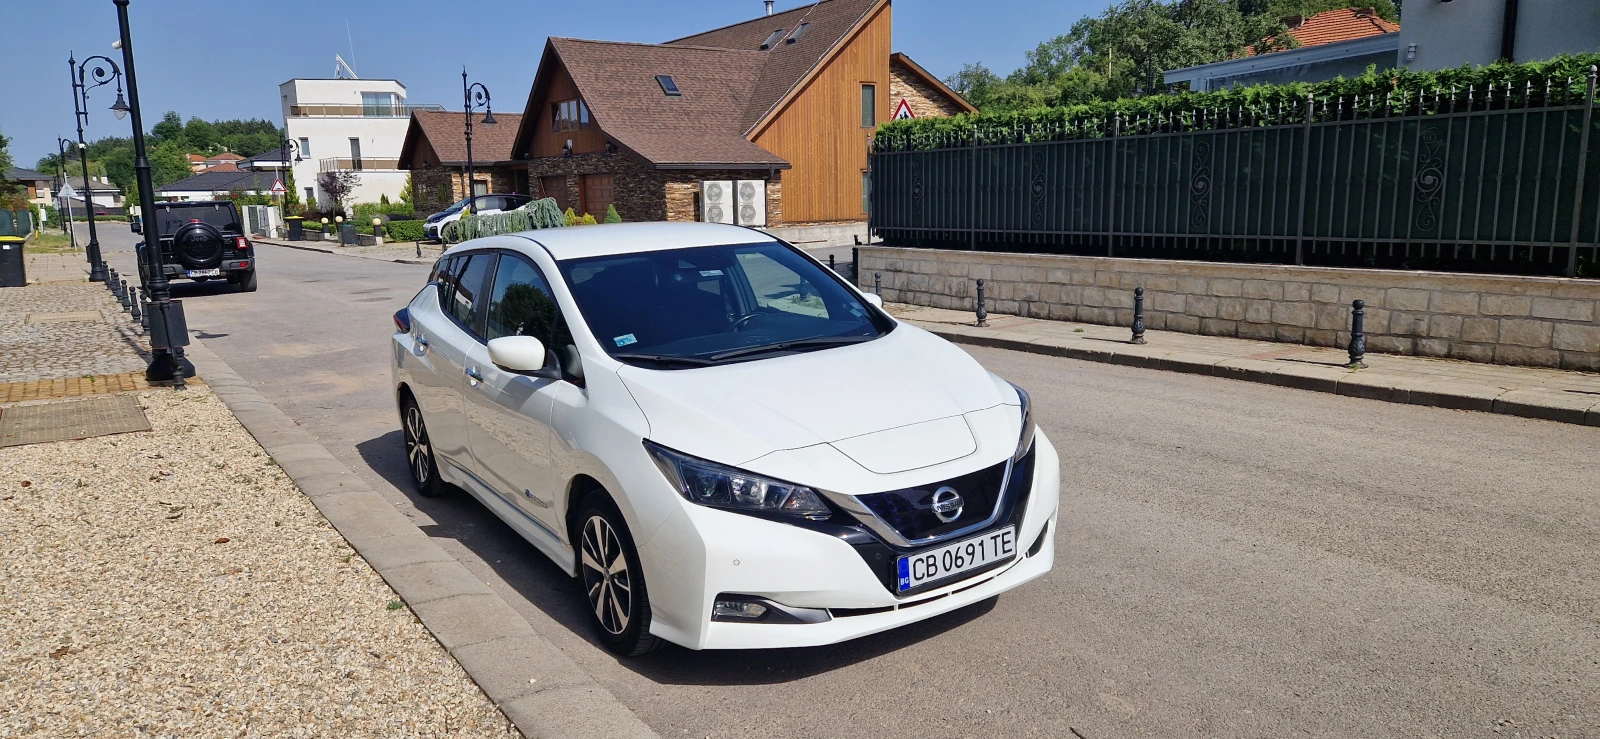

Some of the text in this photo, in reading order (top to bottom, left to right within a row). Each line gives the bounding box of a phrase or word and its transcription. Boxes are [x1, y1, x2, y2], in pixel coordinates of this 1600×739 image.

[936, 499, 963, 511] NISSAN
[912, 531, 1013, 581] CB 0691 TE
[900, 577, 909, 586] BG
